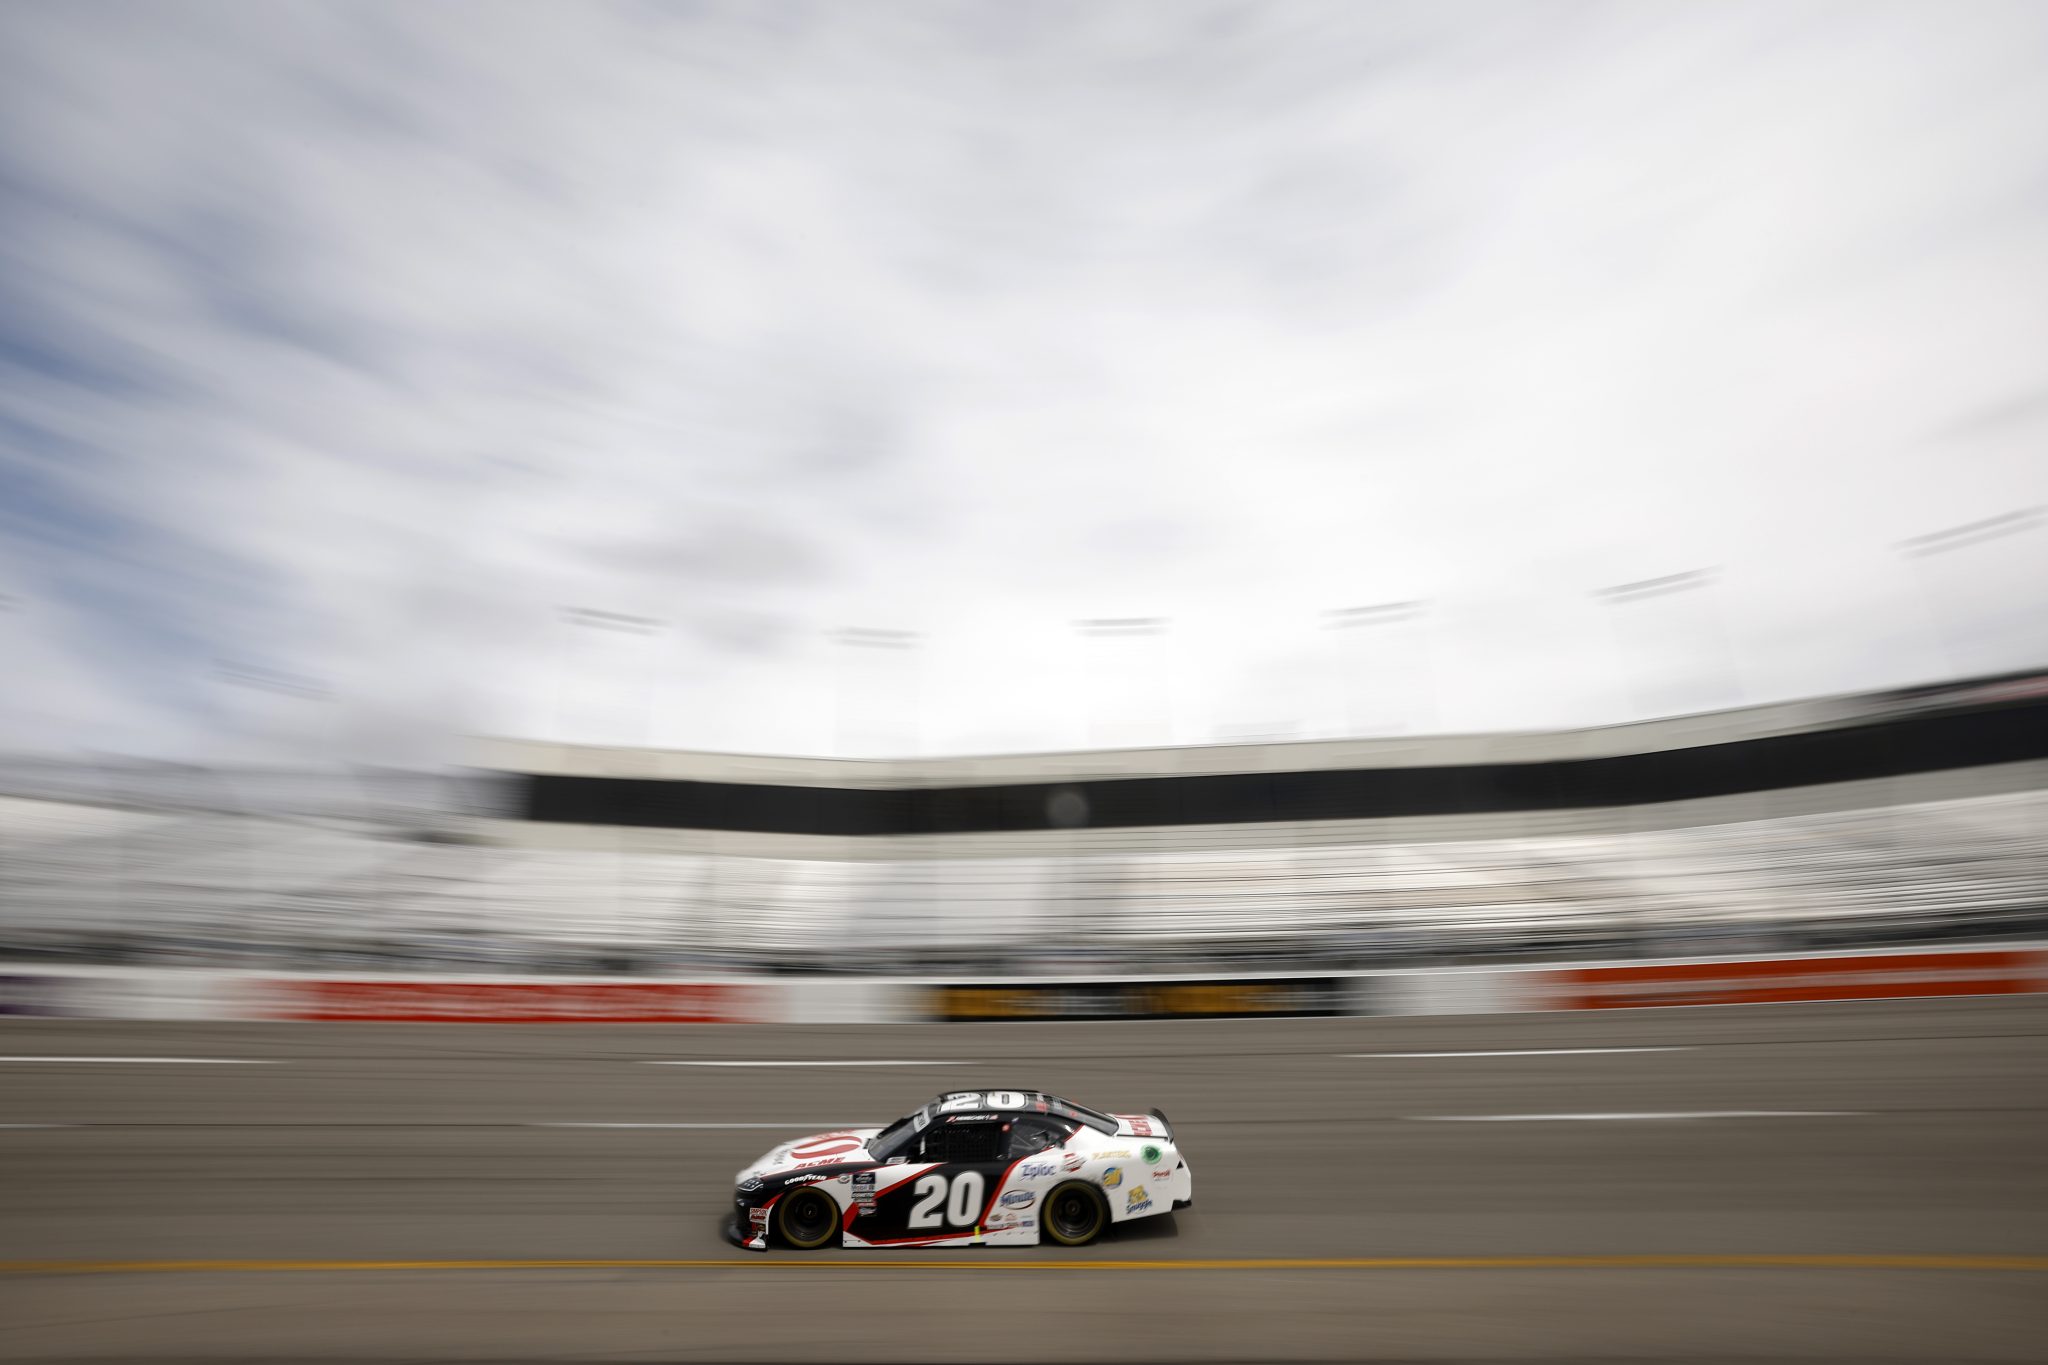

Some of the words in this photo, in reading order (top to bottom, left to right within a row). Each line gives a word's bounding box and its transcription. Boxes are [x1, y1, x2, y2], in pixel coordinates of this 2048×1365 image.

[793, 1157, 845, 1169] ACME
[1020, 1164, 1056, 1180] Ziploc
[785, 1174, 827, 1185] GOODYEAR
[908, 1171, 985, 1229] 20
